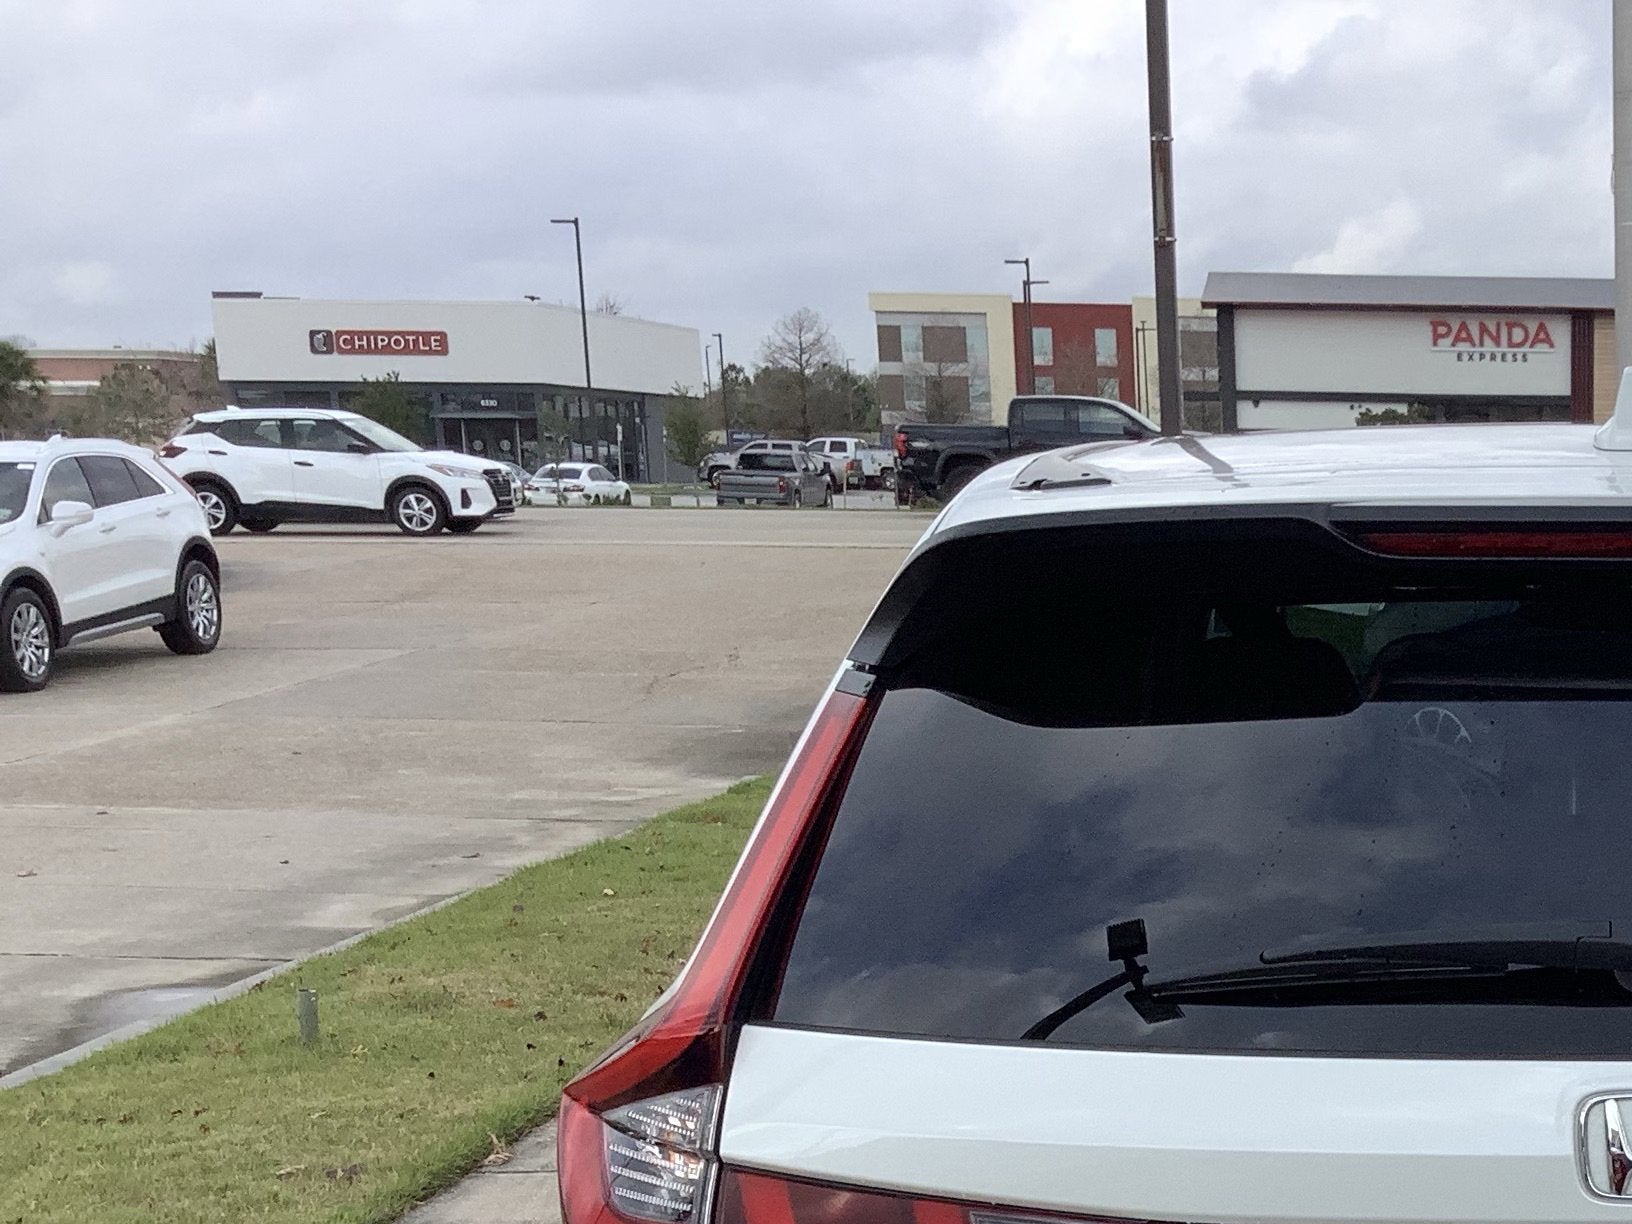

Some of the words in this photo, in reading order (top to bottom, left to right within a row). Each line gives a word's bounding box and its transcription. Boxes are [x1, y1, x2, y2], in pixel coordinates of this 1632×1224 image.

[1430, 320, 1555, 349] PANDA
[339, 335, 442, 350] CHIPOTLE
[1456, 352, 1529, 363] EXPRESS
